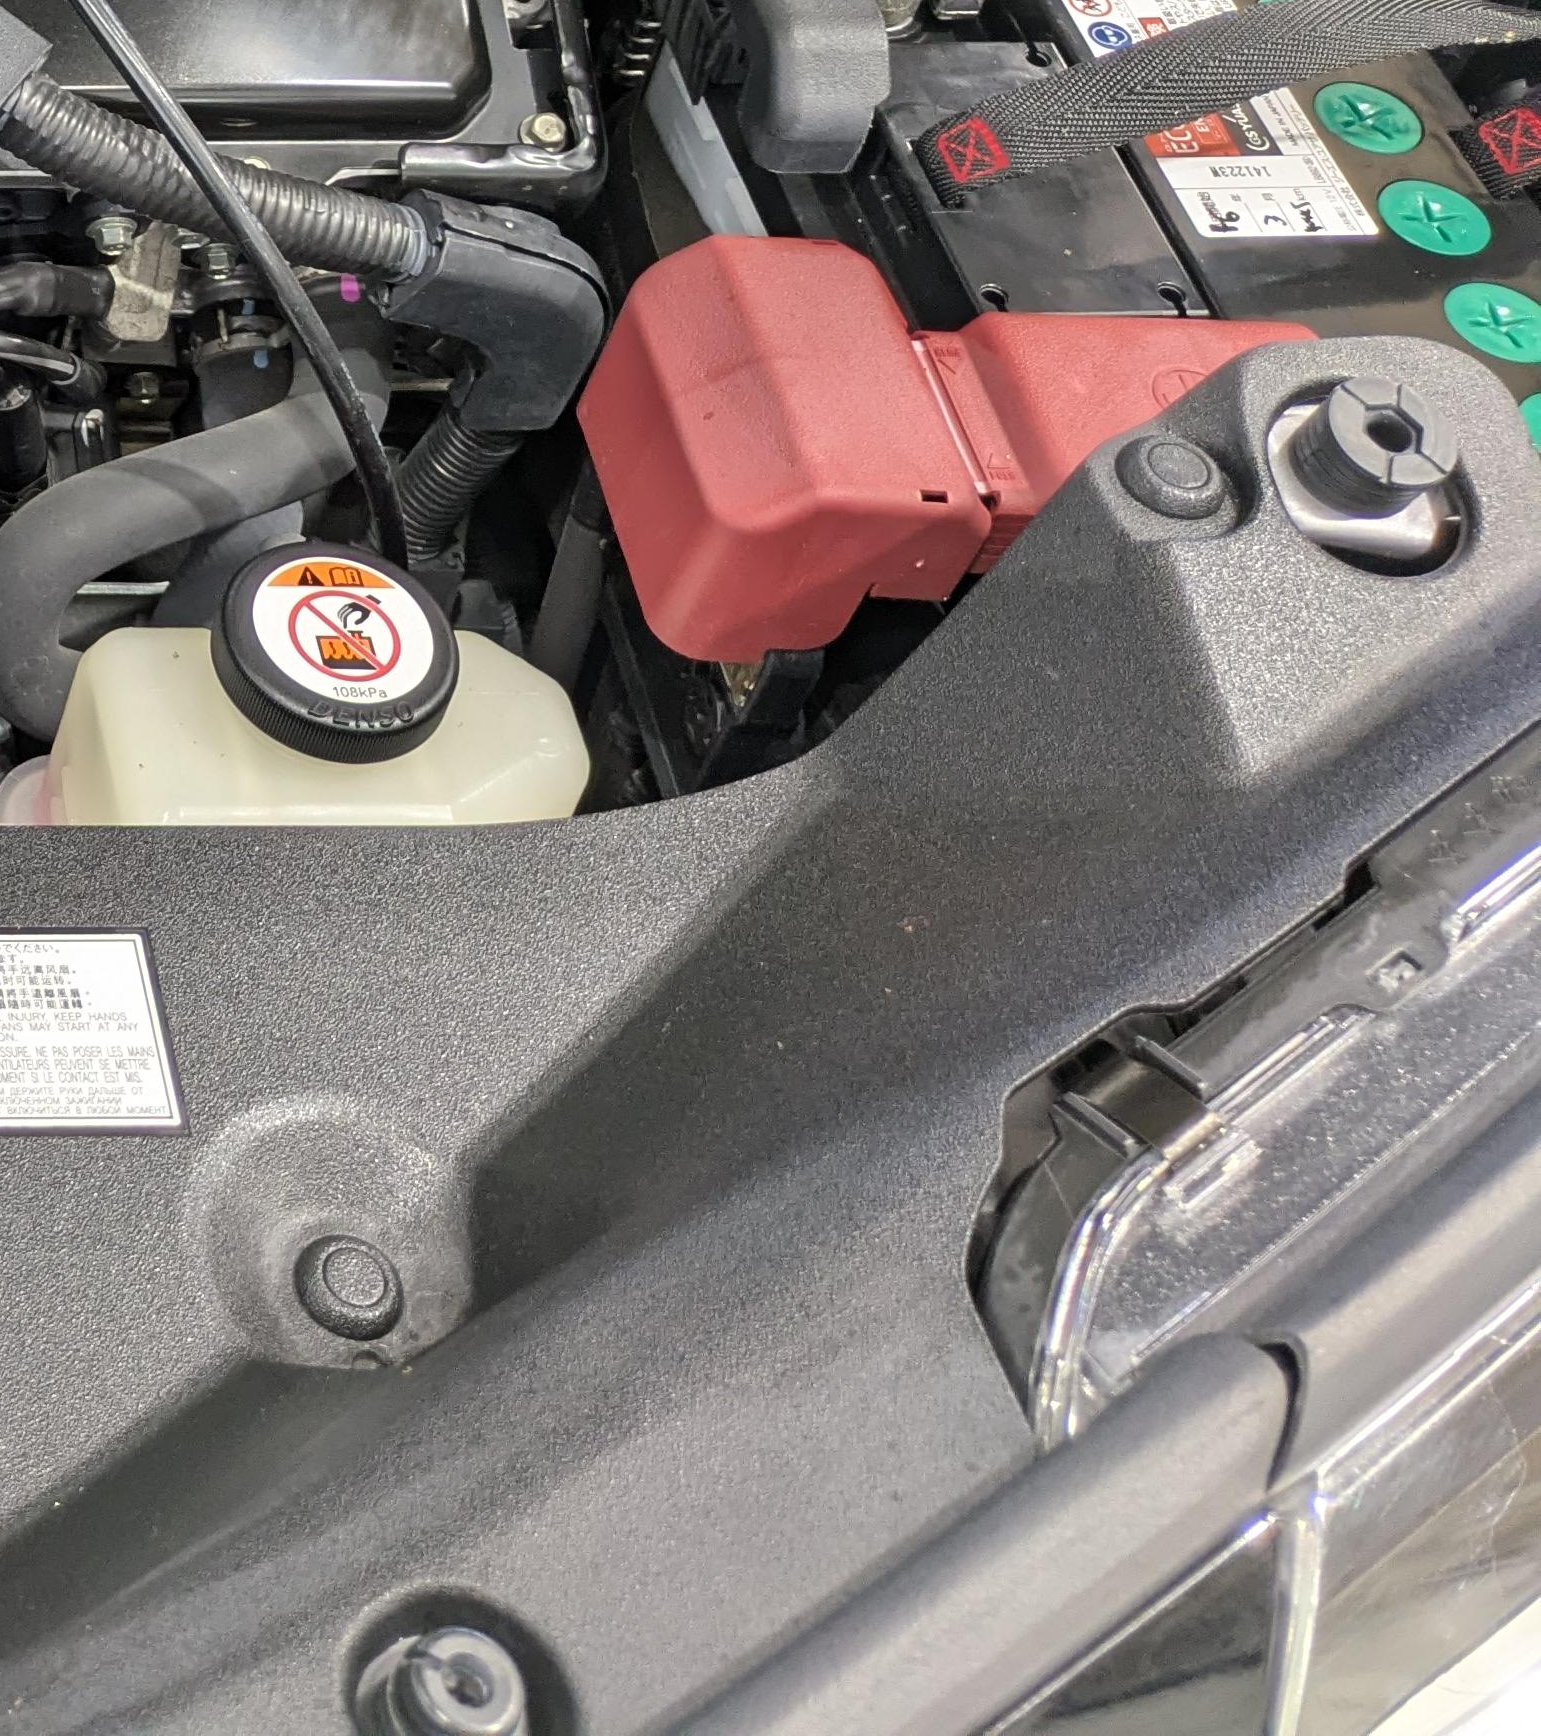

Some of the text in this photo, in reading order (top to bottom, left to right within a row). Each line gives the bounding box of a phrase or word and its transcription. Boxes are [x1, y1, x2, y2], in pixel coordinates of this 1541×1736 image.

[332, 686, 388, 699] 108kPa
[307, 701, 415, 729] DENSO
[53, 1012, 83, 1021] KEEP
[88, 1012, 127, 1021] HANDS
[29, 1023, 52, 1031] MAY
[57, 1022, 92, 1031] START
[97, 1022, 111, 1031] AT
[116, 1022, 139, 1031] ANY
[35, 1046, 48, 1057] NE
[52, 1046, 69, 1057] PAS
[72, 1046, 103, 1057] POSER
[106, 1046, 123, 1057] LES
[127, 1046, 155, 1057] MAINS
[54, 1059, 94, 1070] PEUVENT
[98, 1059, 111, 1070] SE
[115, 1059, 151, 1070] METTRE
[30, 1072, 39, 1083] SI
[43, 1072, 54, 1083] LE
[58, 1072, 99, 1083] CONTACT
[103, 1072, 121, 1083] EST
